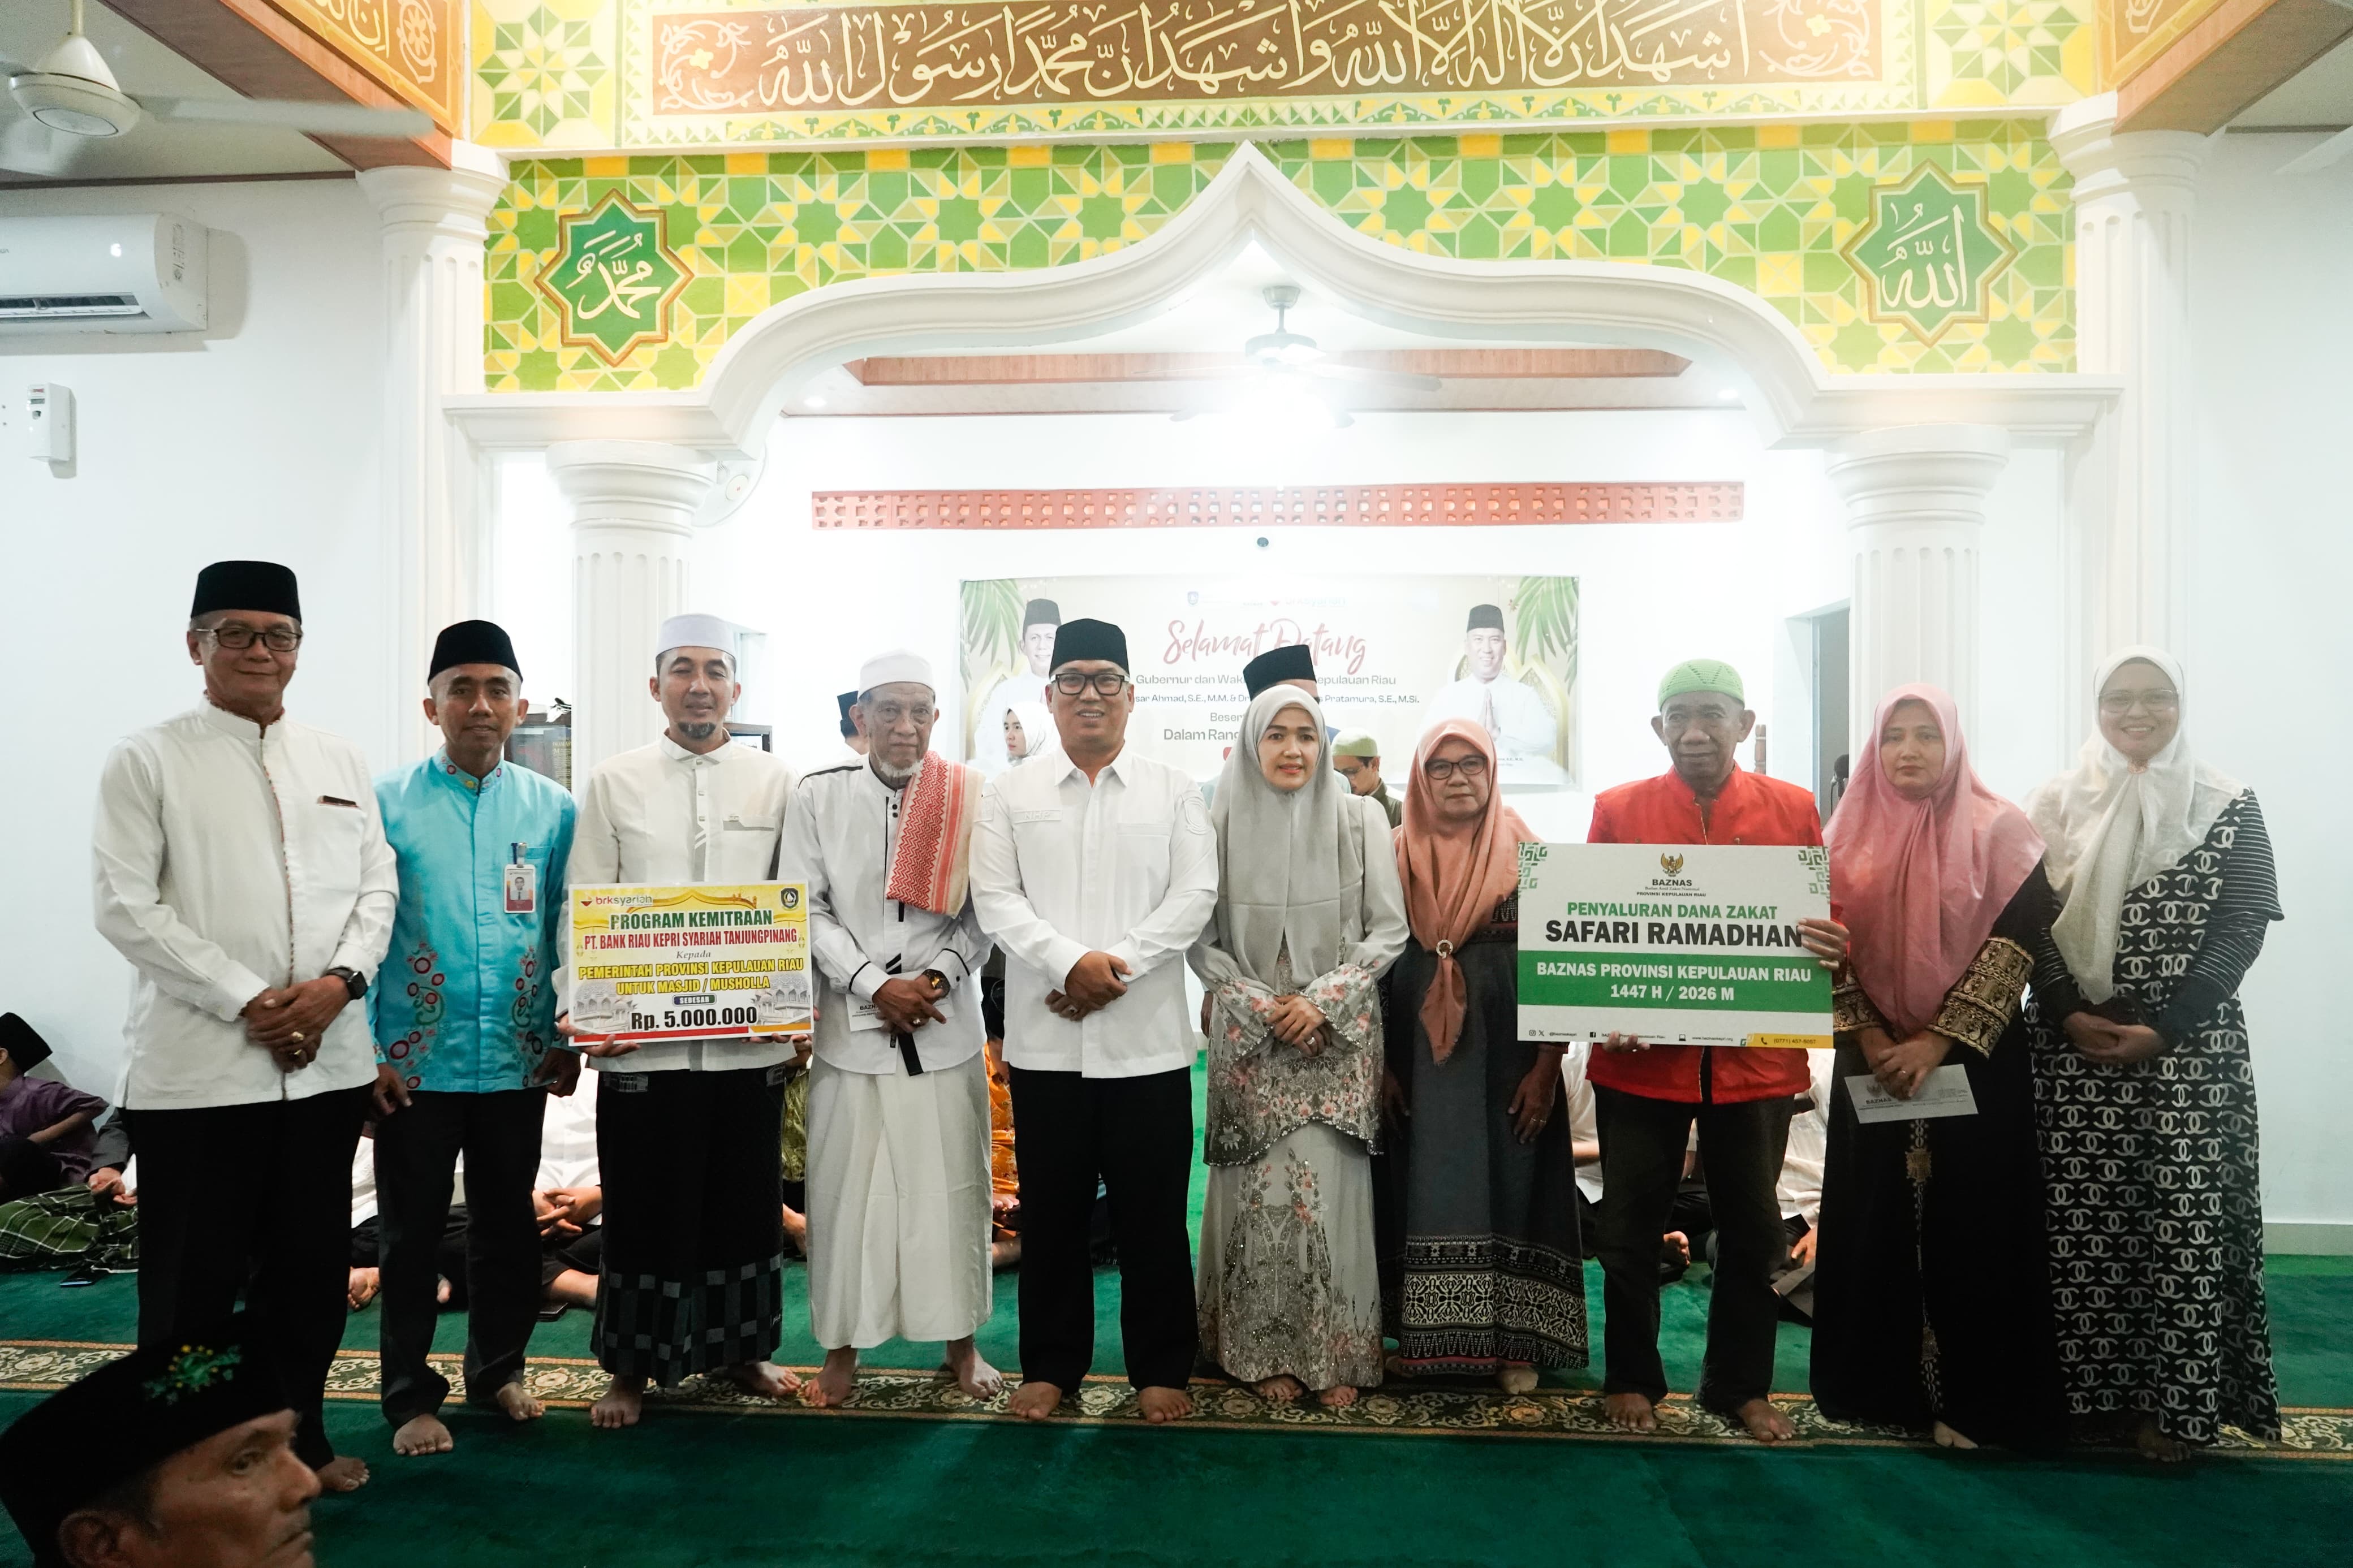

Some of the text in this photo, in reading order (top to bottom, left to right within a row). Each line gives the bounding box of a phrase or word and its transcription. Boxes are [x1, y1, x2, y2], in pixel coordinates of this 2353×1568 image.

[1163, 619, 1269, 665] Selamat
[1136, 675, 1397, 686] Gubernur dan Wak epulauan Riau
[1152, 694, 1187, 703] Ahmad,
[1210, 712, 1244, 722] Beser
[1163, 729, 1206, 741] Dalam
[596, 895, 652, 906] brksyariah
[1567, 902, 1777, 919] PENYALURAN DANA ZAKAT
[610, 910, 772, 930] PROGRAM KEMITRAAN
[584, 928, 797, 950] PT. BANK RIAU KEPRI SYARIAH TANJUNGPINANG
[1545, 920, 1802, 948] SAFARI RAMADHAN
[676, 950, 711, 960] Kepada
[578, 958, 804, 980] PEMERINTAH PROVINSI KEPULAUAN RIAU
[1537, 962, 1811, 982] BAZNAS PROVINSI KEPULAUAN RIAU
[616, 976, 770, 995] UNTUK MASJID / MUSHOLLA
[1610, 984, 1734, 1002] 1447 H / 2026 M
[631, 1007, 757, 1031] Rp. 5.000.000
